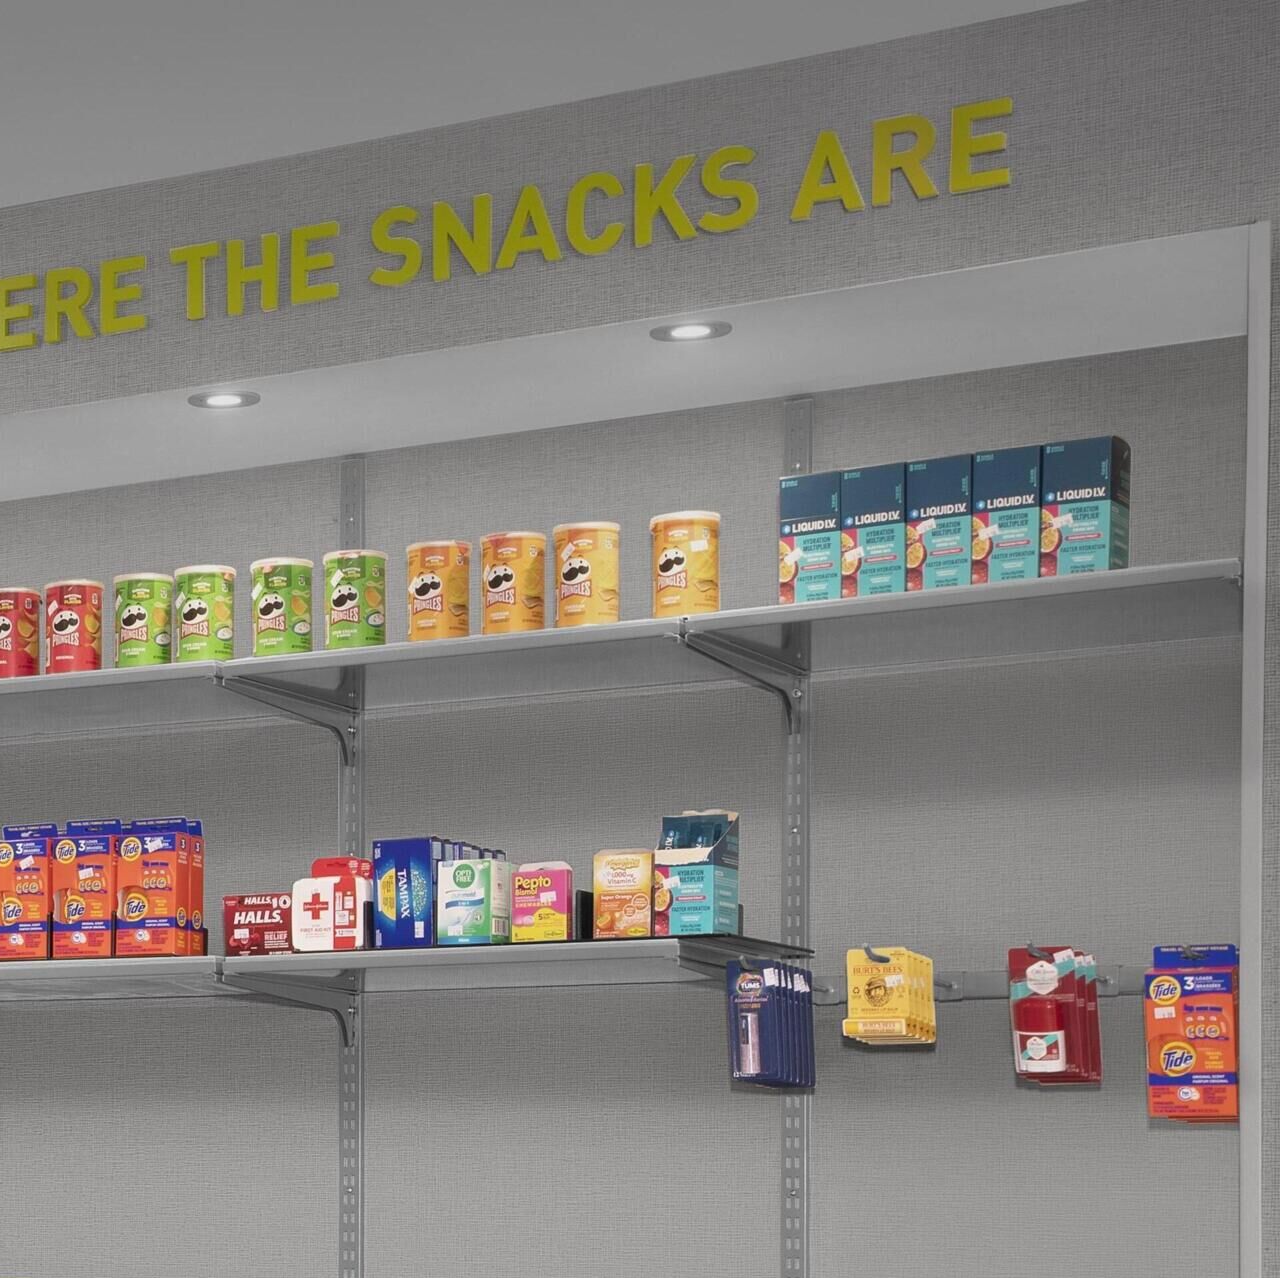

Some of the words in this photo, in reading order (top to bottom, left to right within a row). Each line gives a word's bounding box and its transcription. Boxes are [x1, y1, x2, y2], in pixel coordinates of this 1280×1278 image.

[171, 223, 338, 320] THE
[371, 147, 757, 285] SNACKS
[792, 98, 1012, 219] ARE
[1057, 488, 1092, 500] LIQUID
[987, 496, 1022, 508] LIQUID
[920, 505, 955, 517] LIQUID
[855, 513, 889, 525] LIQUID
[792, 520, 825, 532] LIQUID
[657, 574, 686, 588] PRINGLES
[561, 583, 590, 597] PRINGLES
[487, 591, 515, 605] PRINGLES
[414, 598, 442, 612] PRINGLES
[332, 608, 359, 621] PRINGLES
[182, 623, 208, 636] PRINGLES
[258, 618, 286, 630] PRINGLES
[53, 633, 79, 647] PRINGLES
[121, 627, 147, 641] PRINGLES
[16, 843, 23, 854] 3
[58, 845, 74, 858] Tide
[78, 840, 86, 851] 3
[123, 842, 139, 855] Tide
[515, 877, 551, 889] Pepto
[397, 869, 410, 918] TAMPAX
[4, 904, 22, 917] Tide
[68, 903, 85, 917] Tide
[127, 900, 146, 914] Tide
[1184, 977, 1194, 989] 3
[1152, 983, 1178, 998] Tide
[1163, 1052, 1193, 1070] Tide
